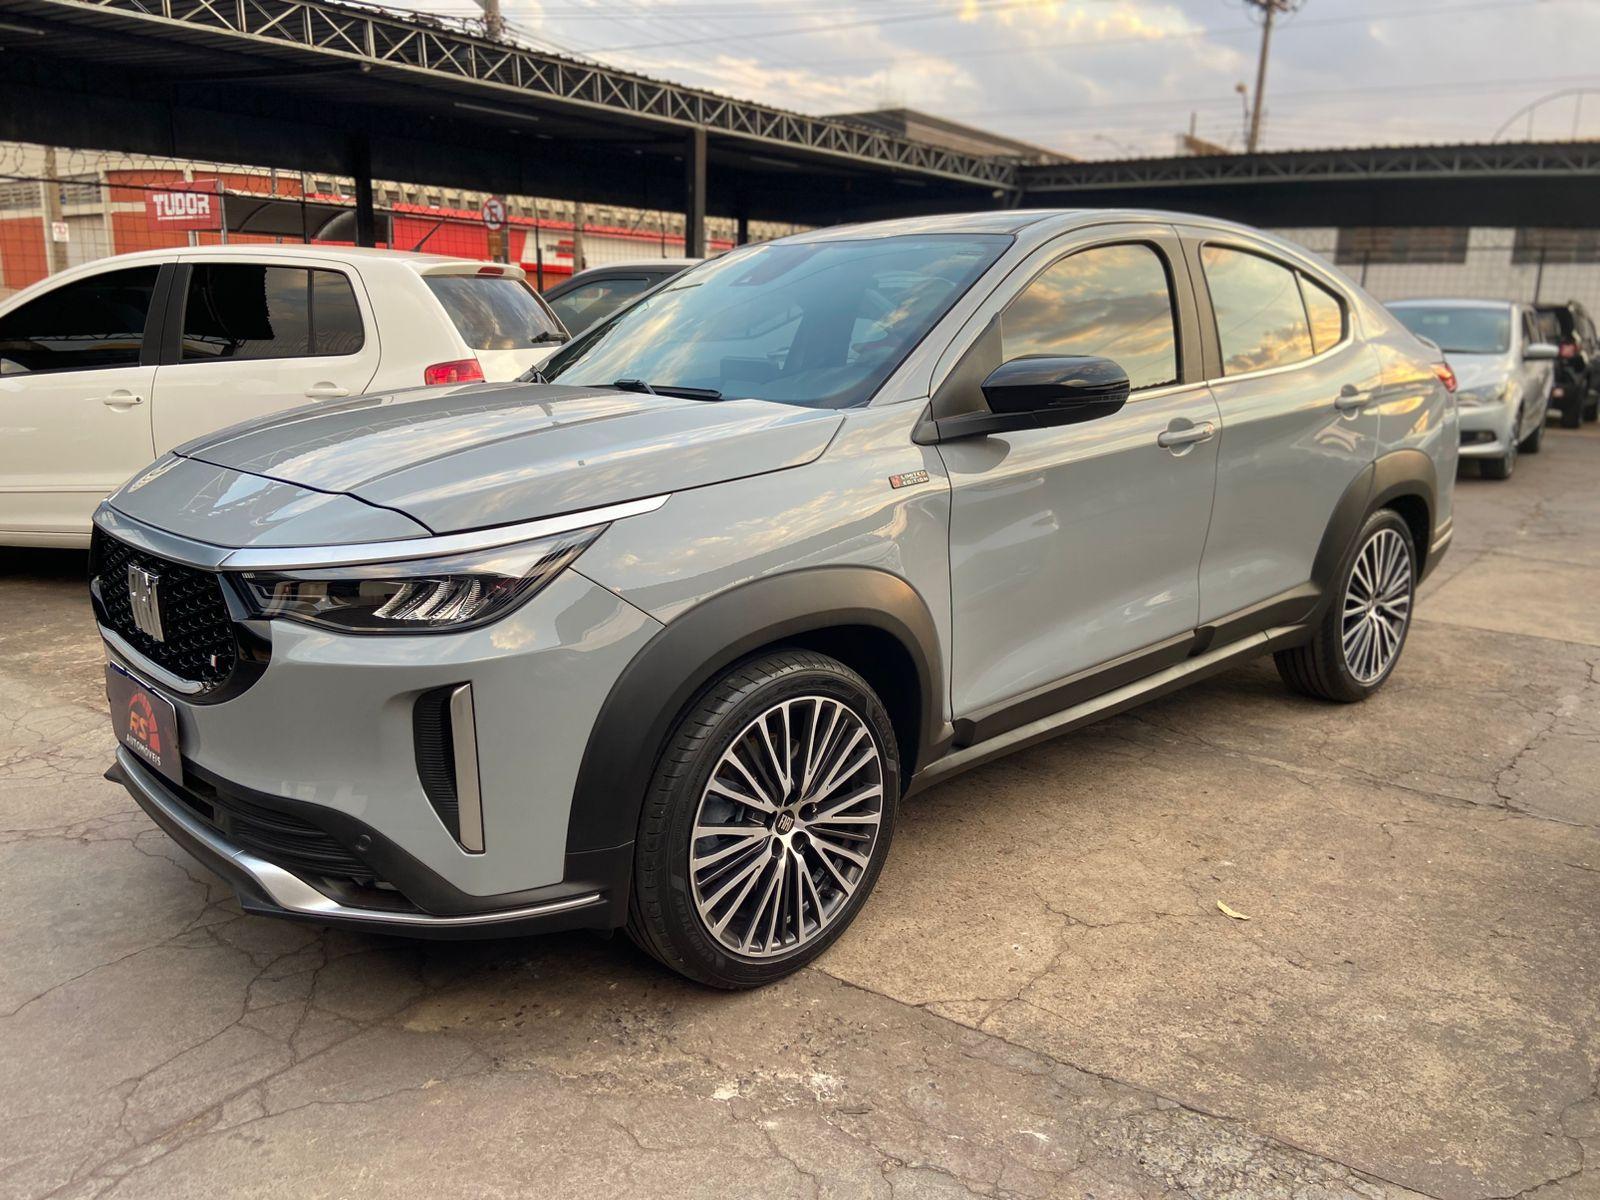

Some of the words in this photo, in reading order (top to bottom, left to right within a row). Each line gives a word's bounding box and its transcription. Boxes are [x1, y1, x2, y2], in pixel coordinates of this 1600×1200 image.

[153, 192, 210, 216] TUDOR
[130, 710, 148, 741] RS
[777, 813, 794, 832] FIAT
